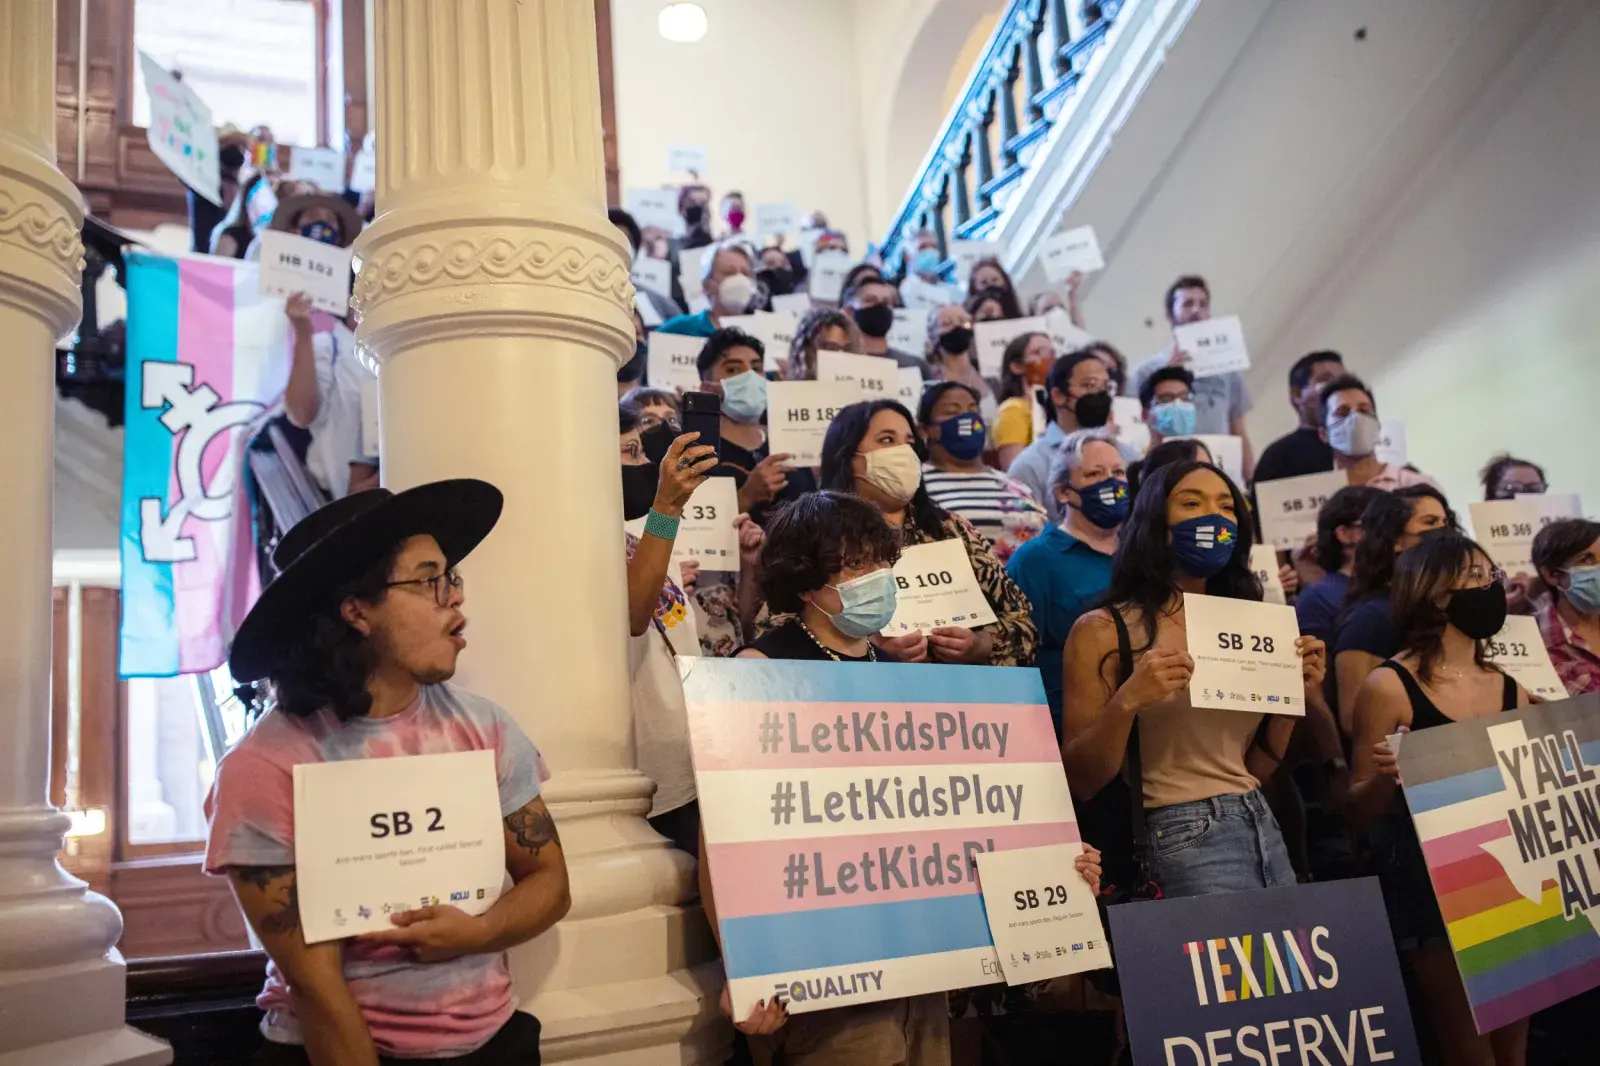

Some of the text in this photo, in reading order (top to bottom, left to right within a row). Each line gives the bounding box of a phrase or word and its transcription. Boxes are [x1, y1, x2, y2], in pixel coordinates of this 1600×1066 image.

[787, 407, 810, 422] HB
[692, 505, 717, 520] 33
[1282, 498, 1304, 513] SB
[1490, 524, 1509, 538] HB
[915, 570, 953, 588] 100
[1217, 631, 1275, 654] SB 28
[1491, 641, 1529, 657] SB 32
[758, 710, 1010, 758] #LetKidsPlay
[1497, 729, 1596, 800] Y'ALL
[770, 773, 1024, 826] #LetKidsPlay
[369, 806, 445, 840] SB 2
[783, 838, 996, 899] #LetKidsP
[1556, 847, 1600, 918] AL
[450, 890, 470, 901] ACLU
[1013, 884, 1068, 911] SB 29
[1182, 925, 1340, 1006] TEXANS
[774, 969, 883, 1003] EQUALITY
[1163, 1005, 1395, 1066] DESERVE
